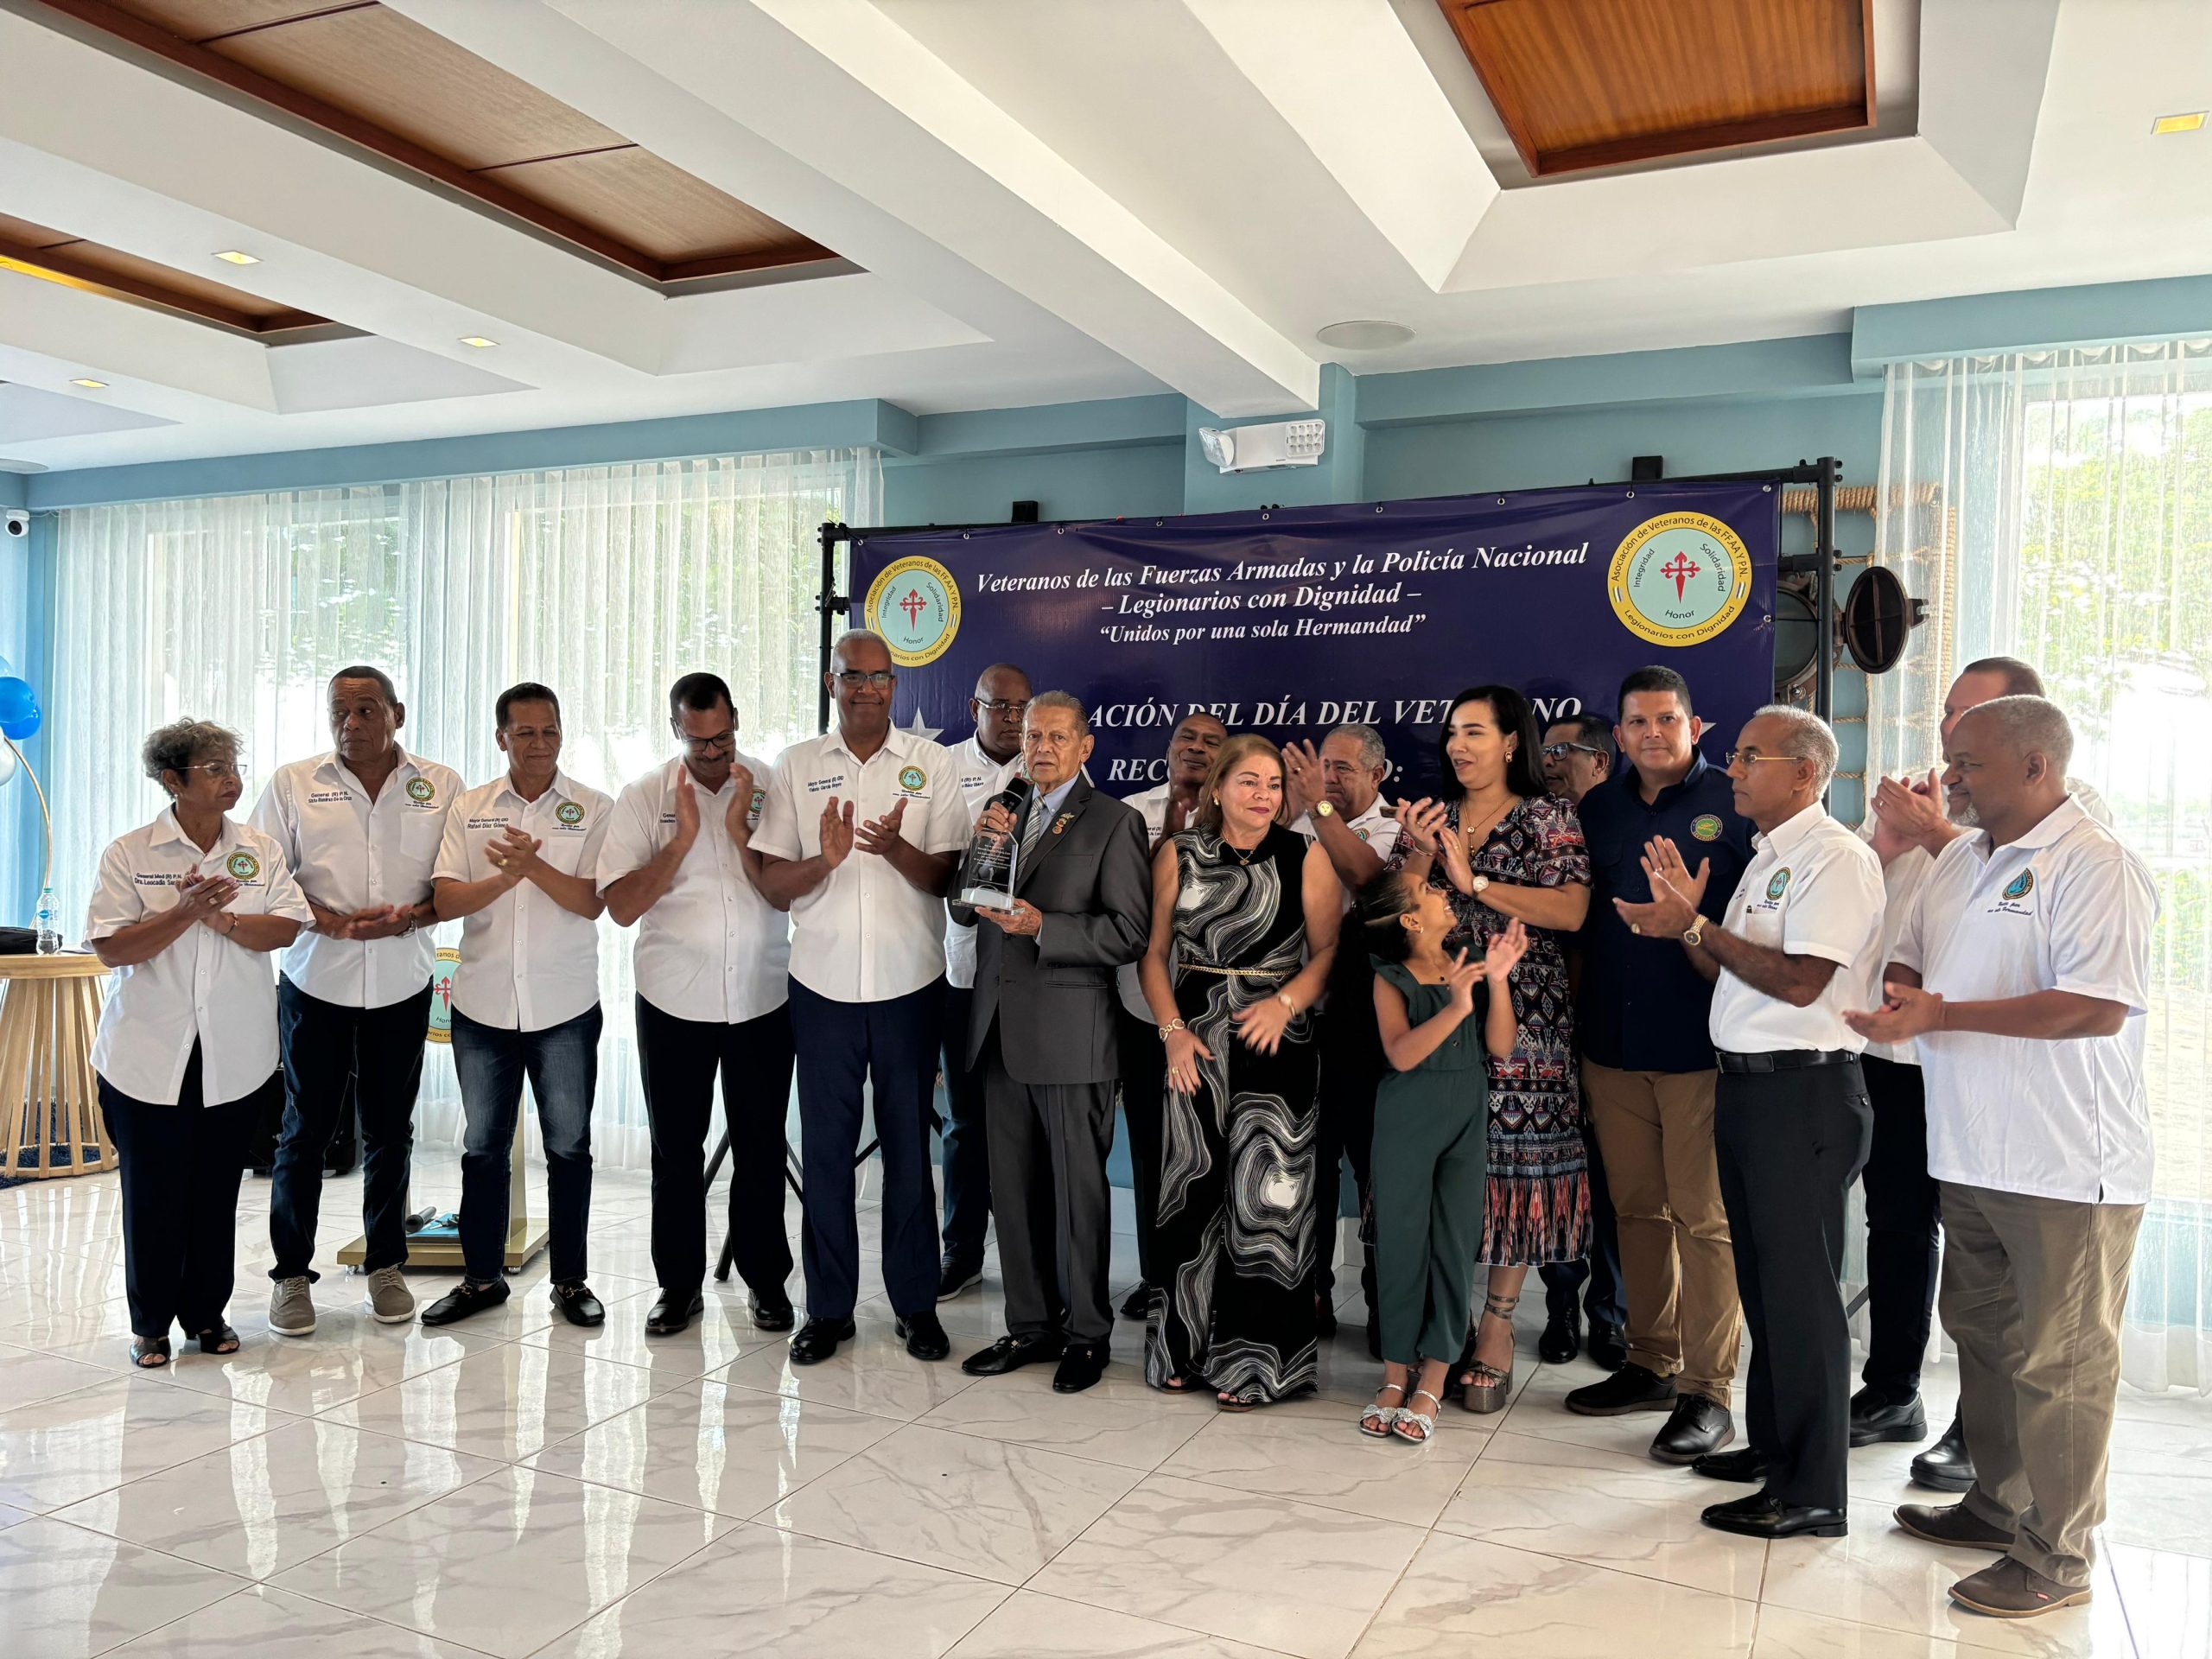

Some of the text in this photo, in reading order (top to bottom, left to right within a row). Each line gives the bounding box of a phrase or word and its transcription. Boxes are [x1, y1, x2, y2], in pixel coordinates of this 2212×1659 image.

[977, 543, 1589, 593] Veteranos de las Fuerzas Armadas y la Policía Nacional
[1611, 537, 1638, 582] Asociación
[1637, 529, 1649, 538] de
[1648, 518, 1694, 531] Veteranos
[1697, 518, 1708, 528] de
[1709, 522, 1722, 535] las
[1634, 548, 1656, 588] Integridad
[1700, 543, 1726, 593] Solidaridad
[867, 577, 886, 613] Asociación
[884, 569, 893, 578] de
[892, 561, 924, 571] Veteranos
[924, 561, 932, 569] de
[932, 565, 942, 575] las
[881, 586, 897, 619] Integridad
[925, 582, 944, 622] Solidaridad
[1117, 590, 1241, 619] Legionarios
[1248, 592, 1287, 609] con
[1293, 582, 1403, 611] Dignidad
[1100, 613, 1427, 645] “Unidos por una sola Hermandad”
[1624, 609, 1674, 639] Legionarios
[1696, 606, 1735, 636] Dignidad
[1664, 609, 1695, 620] Honor
[890, 652, 910, 661] narios
[925, 633, 950, 658] Dignidad
[1088, 696, 1179, 728] ACIÓN
[1251, 695, 1306, 726] DÍA
[1315, 700, 1382, 725] DEL
